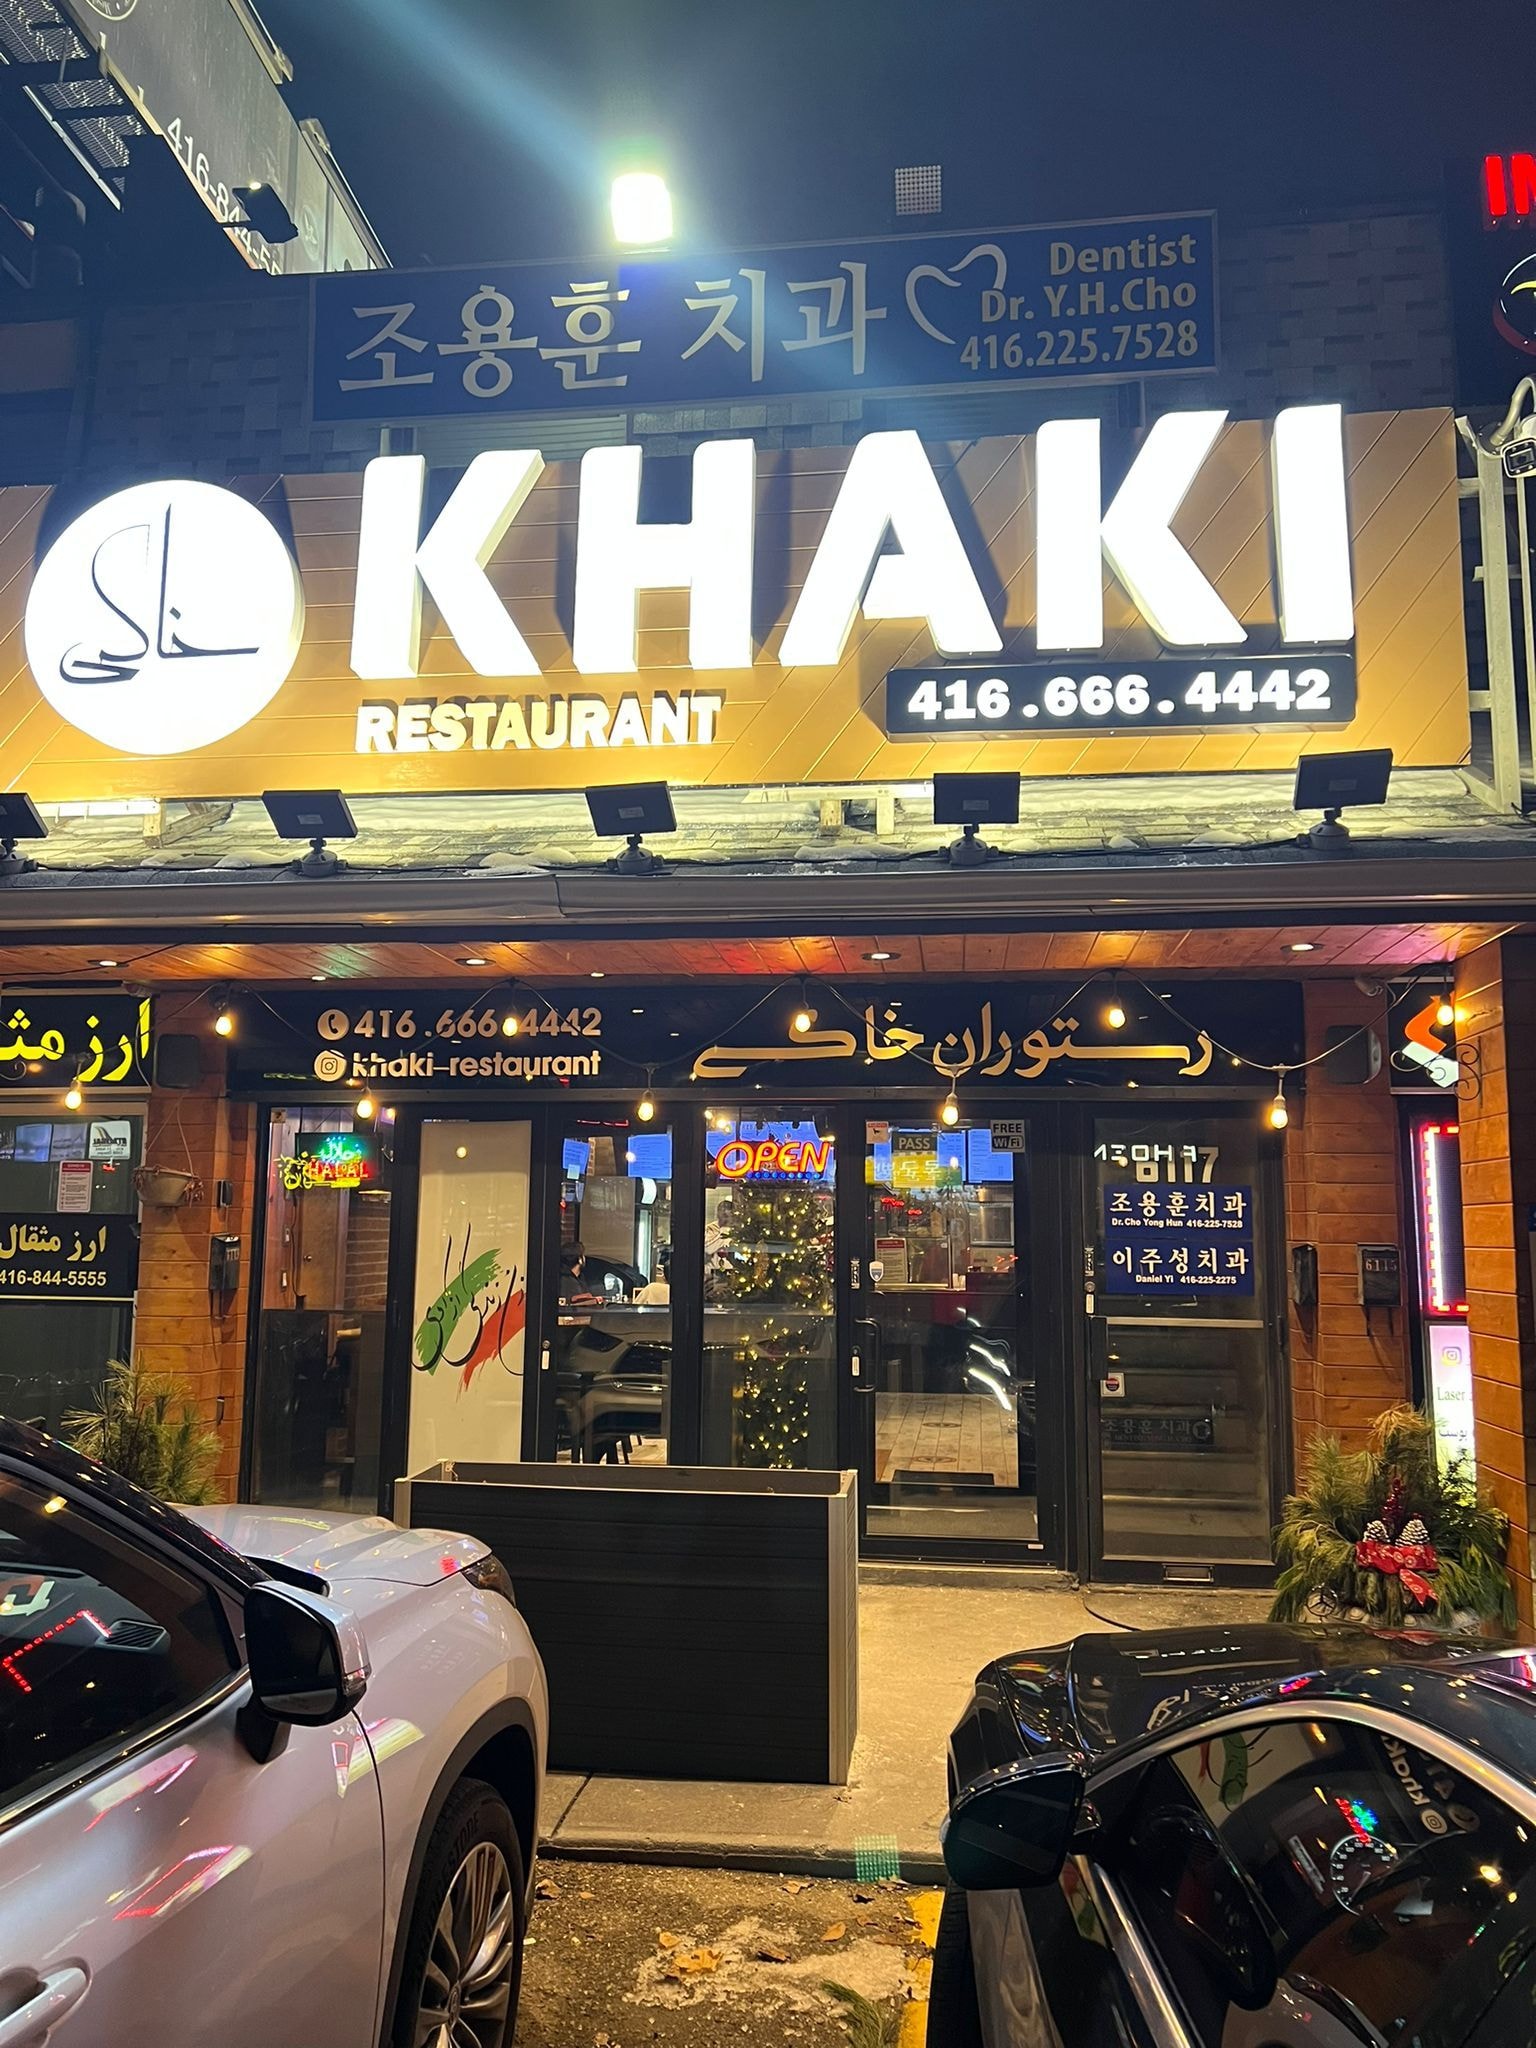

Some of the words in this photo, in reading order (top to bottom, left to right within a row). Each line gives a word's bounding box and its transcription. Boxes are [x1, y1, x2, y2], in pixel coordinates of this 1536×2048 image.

[1050, 233, 1197, 276] Dentist
[981, 289, 1034, 322] Dr.
[1044, 276, 1197, 318] Y.H.Cho
[338, 280, 642, 398] 조용훈
[681, 260, 888, 383] 치과
[960, 319, 1198, 371] 416.225.7528
[350, 403, 1355, 680] KHAKI
[354, 694, 724, 755] RESTAURANT
[72, 997, 151, 1083] ارز
[898, 1137, 931, 1150] PASS
[992, 1122, 1022, 1134] FREE
[715, 1140, 833, 1178] OPEN
[66, 1225, 107, 1262] ارز
[1143, 1218, 1164, 1229] Yong
[1166, 1218, 1184, 1228] Hun
[1437, 1386, 1466, 1401] Laser
